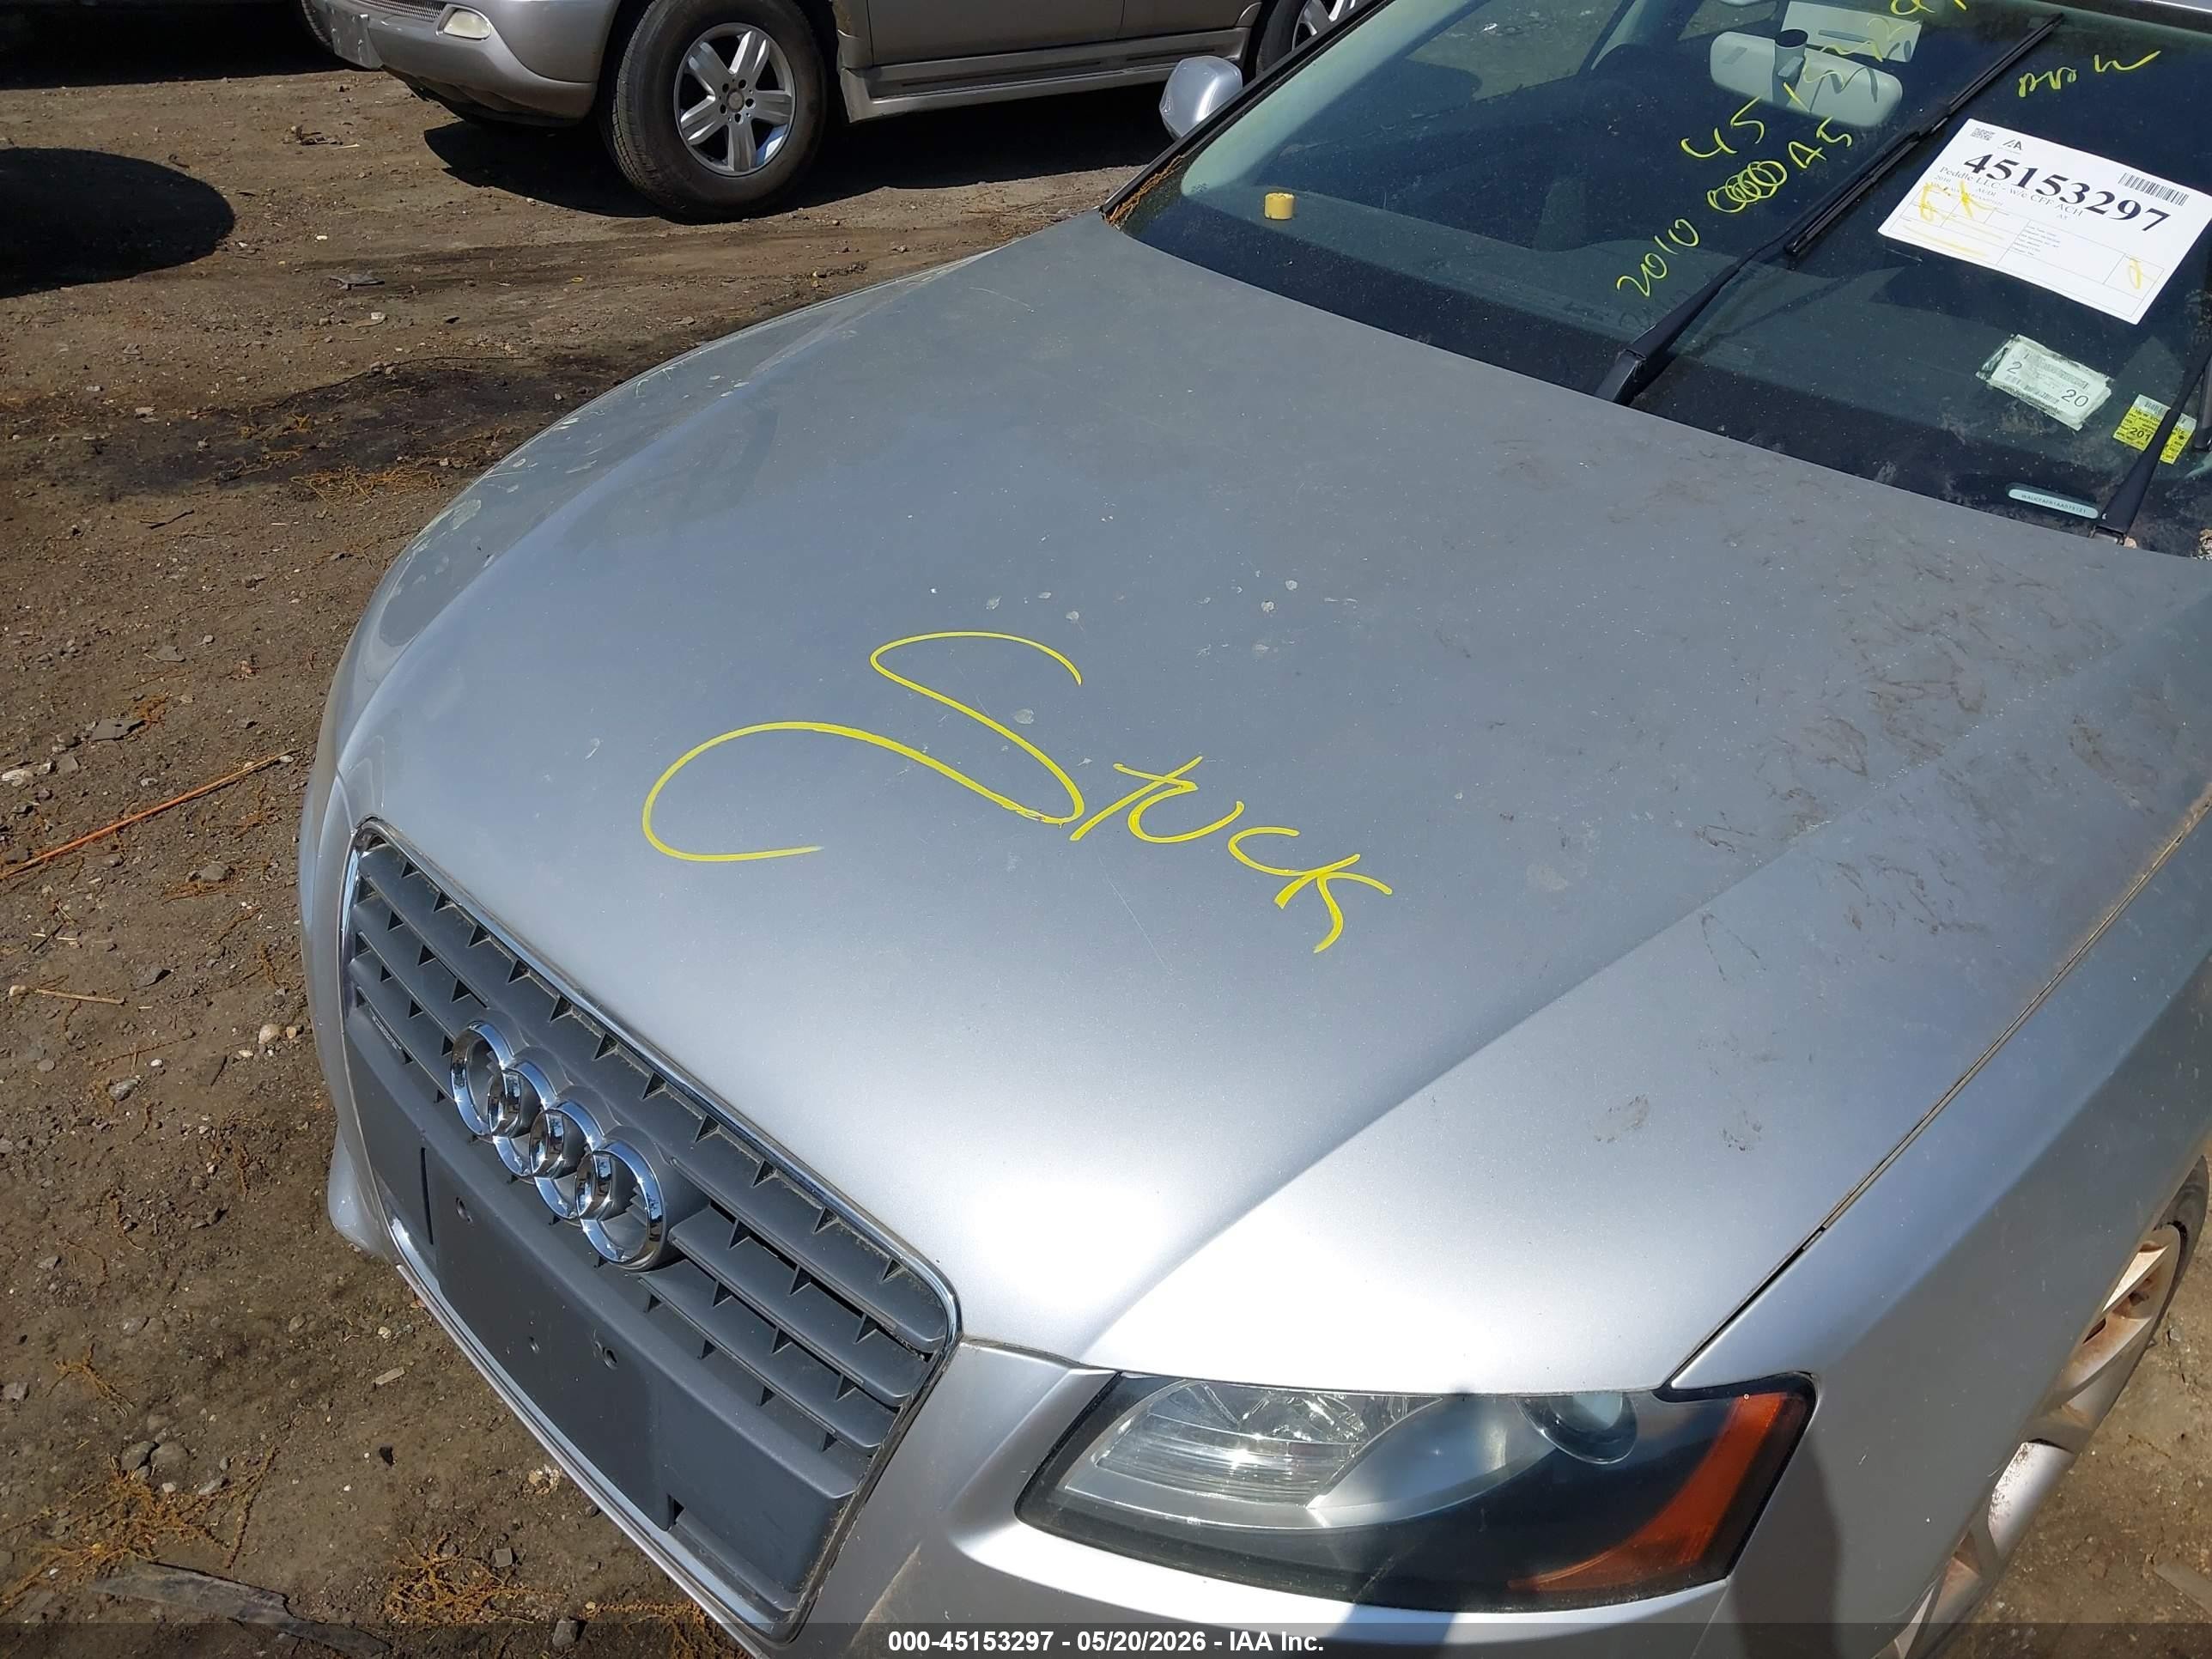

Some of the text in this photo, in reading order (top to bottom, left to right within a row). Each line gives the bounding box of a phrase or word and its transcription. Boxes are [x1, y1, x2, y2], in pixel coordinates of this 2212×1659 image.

[1939, 166, 1974, 181] Peddle
[1975, 177, 2001, 189] LLC
[1963, 154, 2171, 231] 45153297
[1616, 117, 1853, 297] 2010 A5
[2007, 361, 2022, 374] 2
[2061, 389, 2089, 407] 20
[2130, 428, 2151, 441] 201
[642, 631, 1392, 953] Stuck
